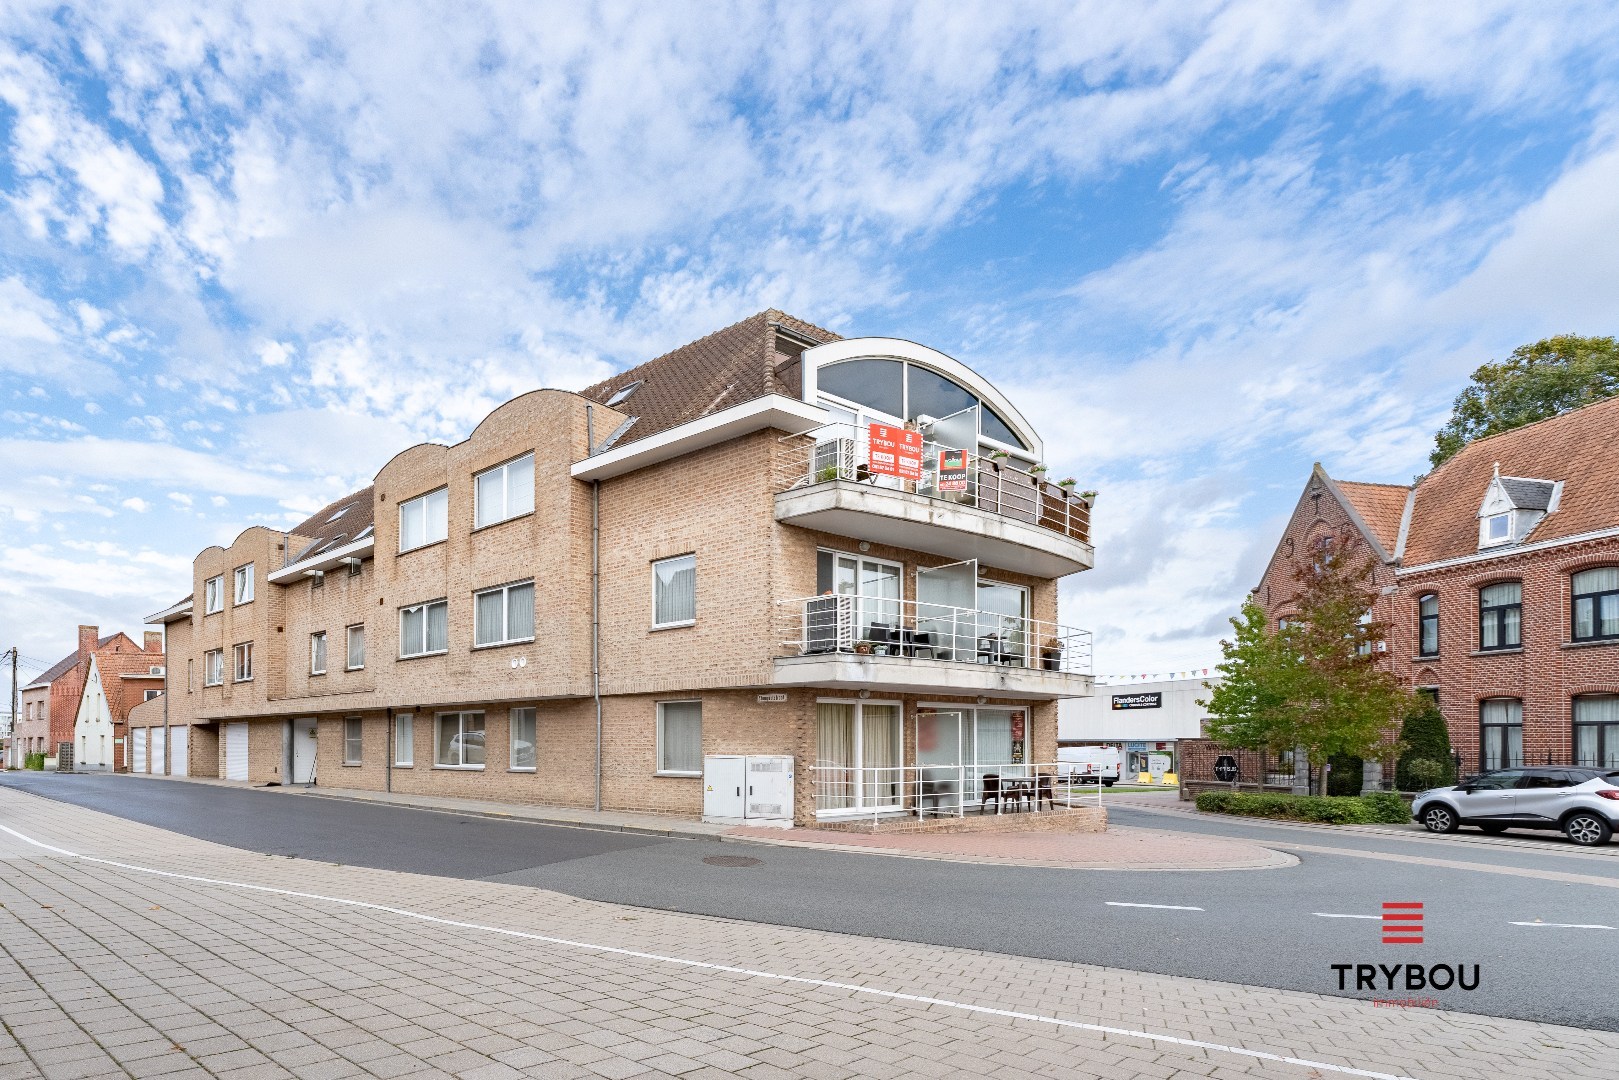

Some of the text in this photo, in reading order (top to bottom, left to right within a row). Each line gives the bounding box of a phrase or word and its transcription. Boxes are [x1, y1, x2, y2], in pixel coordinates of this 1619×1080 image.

[872, 438, 895, 448] TRYBOU
[900, 444, 920, 453] TRYBOU
[948, 473, 966, 481] KOOP
[1113, 695, 1158, 704] FlandersColor
